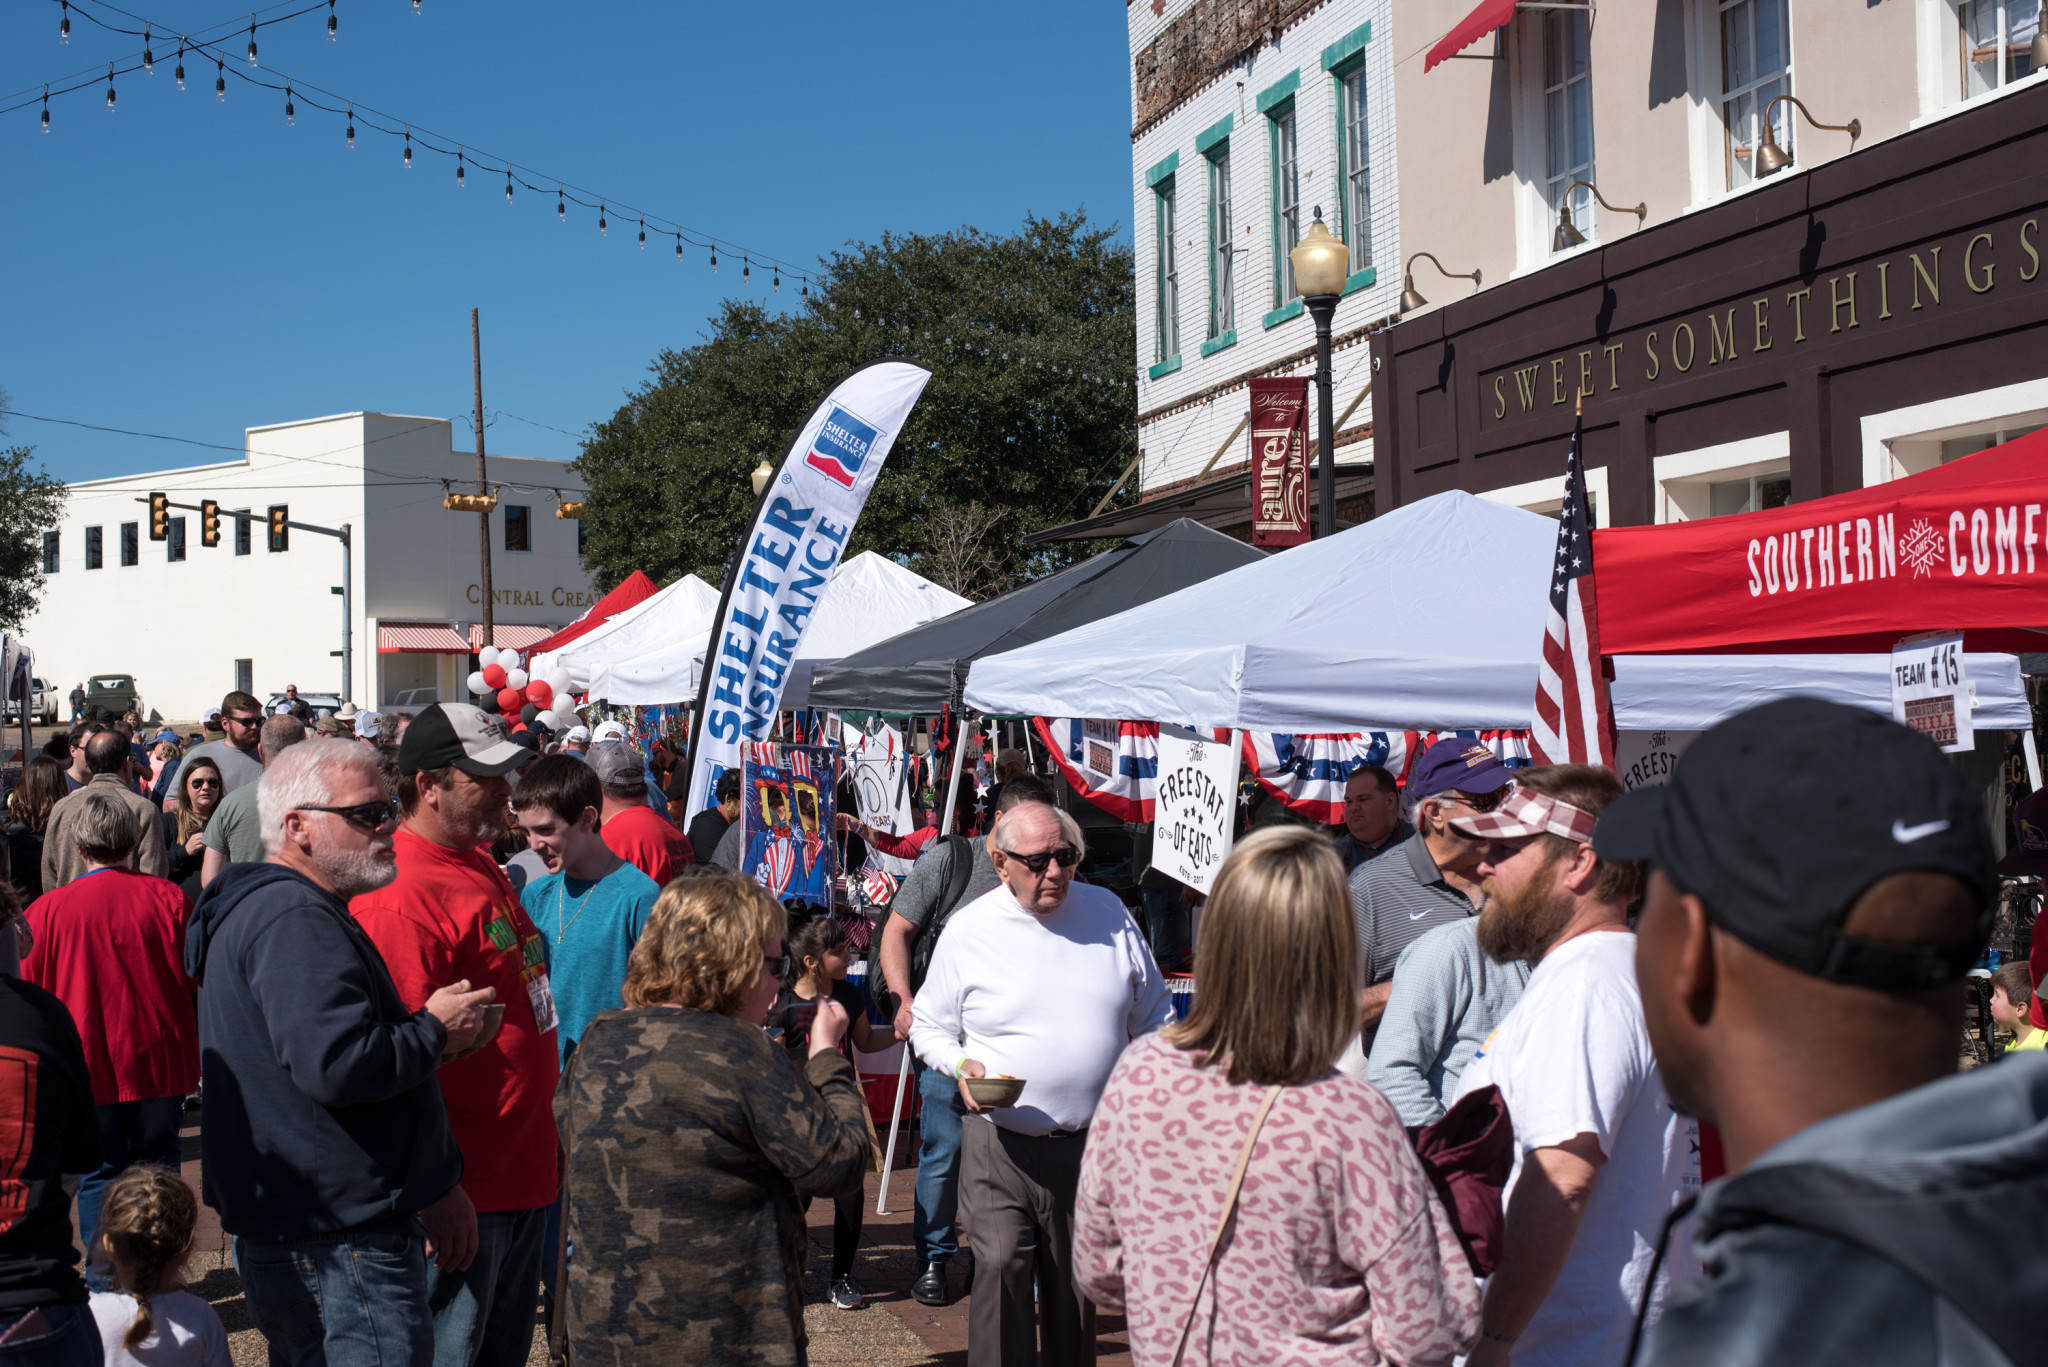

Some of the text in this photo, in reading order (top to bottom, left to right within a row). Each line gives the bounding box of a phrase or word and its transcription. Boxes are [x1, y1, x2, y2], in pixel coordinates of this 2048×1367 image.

[1495, 219, 2040, 419] SWEET SOMETHINGS
[1254, 392, 1304, 410] Welcome
[1273, 412, 1291, 422] to
[821, 430, 865, 459] INSURANCE
[825, 421, 868, 453] SHELTER
[1253, 427, 1302, 533] Laurel
[1747, 503, 2048, 597] SOUTHERN COMF
[1915, 536, 1929, 557] ONE
[466, 584, 544, 606] CNTRAL
[708, 496, 815, 745] SHELTER
[742, 515, 848, 742] NSURANCE
[1895, 662, 1926, 688] TEAM
[1906, 713, 1956, 732] CHILI
[1189, 741, 1204, 762] The
[1652, 730, 1667, 749] The
[1624, 752, 1678, 792] FREEST
[1173, 820, 1212, 869] OF EATS
